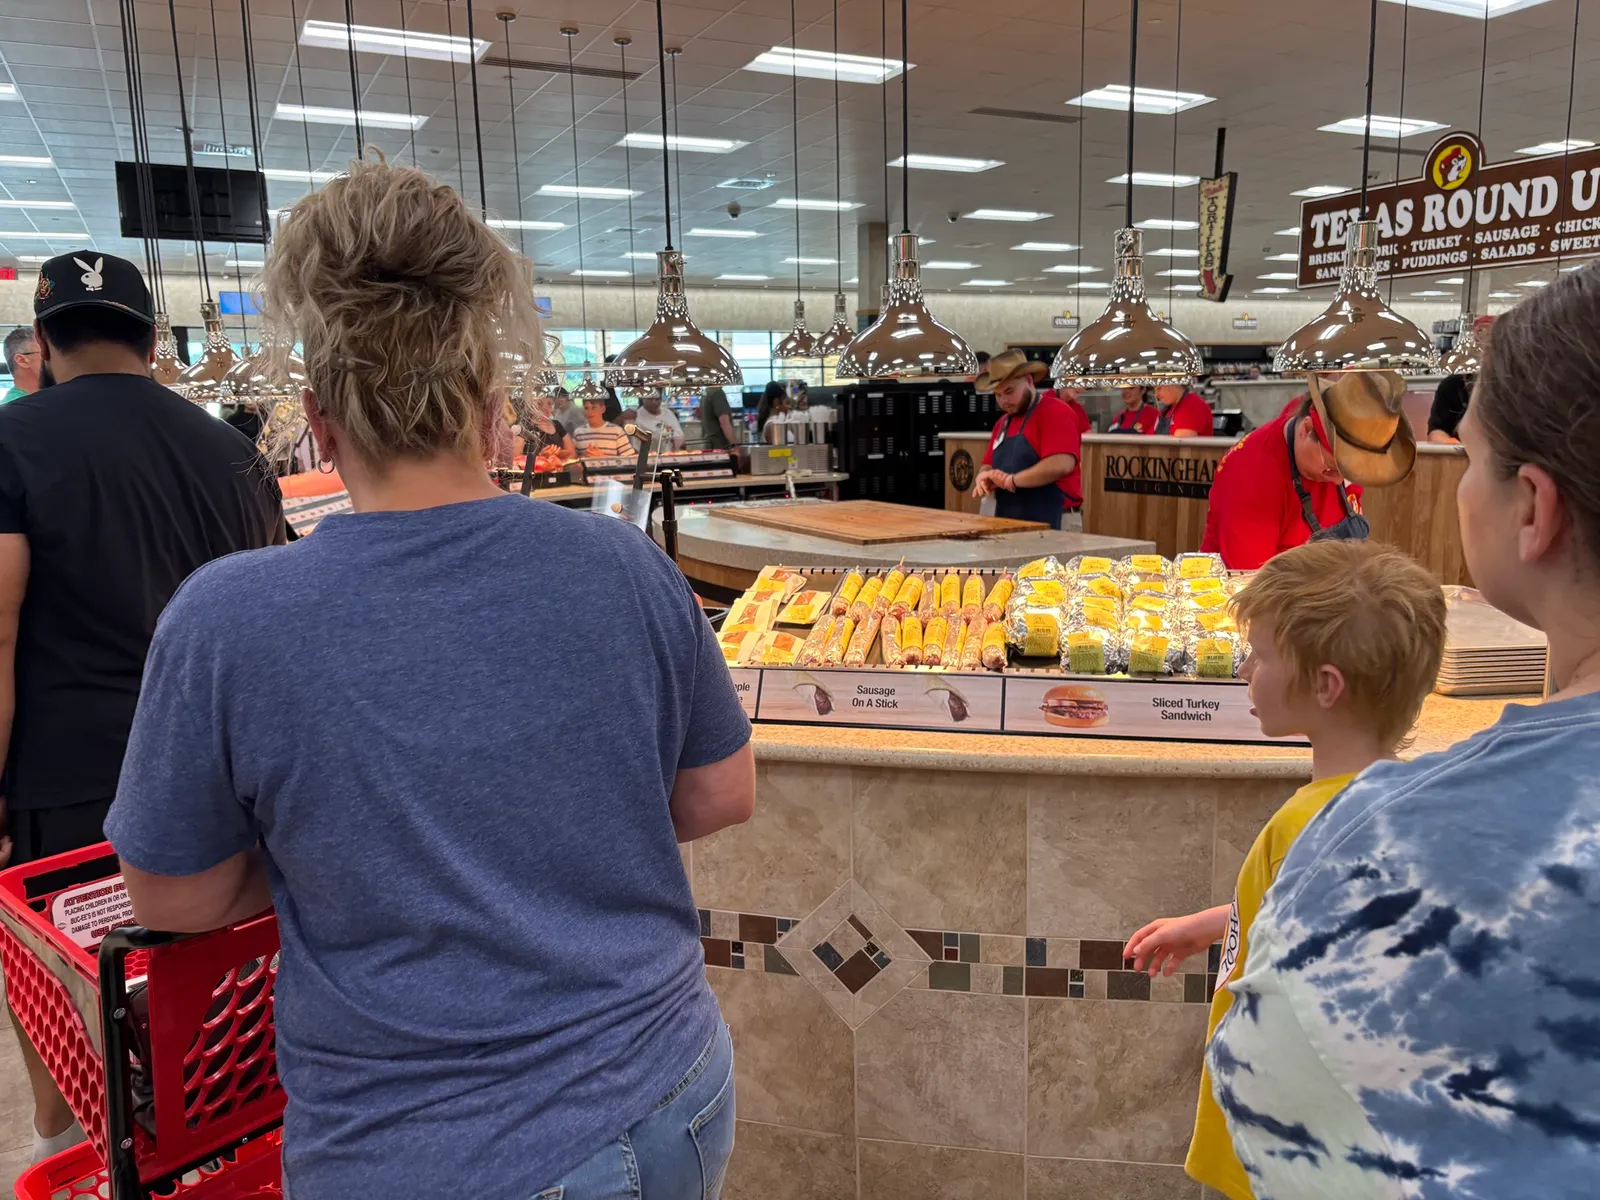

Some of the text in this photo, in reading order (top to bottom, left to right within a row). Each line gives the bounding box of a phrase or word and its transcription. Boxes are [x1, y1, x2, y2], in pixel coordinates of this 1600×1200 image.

[1421, 175, 1558, 232] ROUND
[1308, 250, 1347, 266] BRISKE
[1376, 243, 1398, 257] ORK
[1411, 235, 1462, 252] TURKEY
[1474, 224, 1540, 244] SAUSAGE
[1402, 250, 1468, 269] PUDDINGS
[1481, 242, 1535, 260] SALADS
[856, 684, 896, 697] Sausage
[852, 698, 899, 709] On A Stick
[1152, 697, 1220, 711] Sliced Turkey
[1161, 709, 1212, 721] Sandwich
[64, 886, 113, 907] ATTENTION
[65, 904, 85, 916] PLACING
[85, 898, 107, 910] CHILDREN
[71, 913, 91, 924] BUC-EE'S
[97, 908, 106, 917] NOT
[71, 922, 91, 934] DAMAGE
[98, 914, 121, 925] PERSONAL
